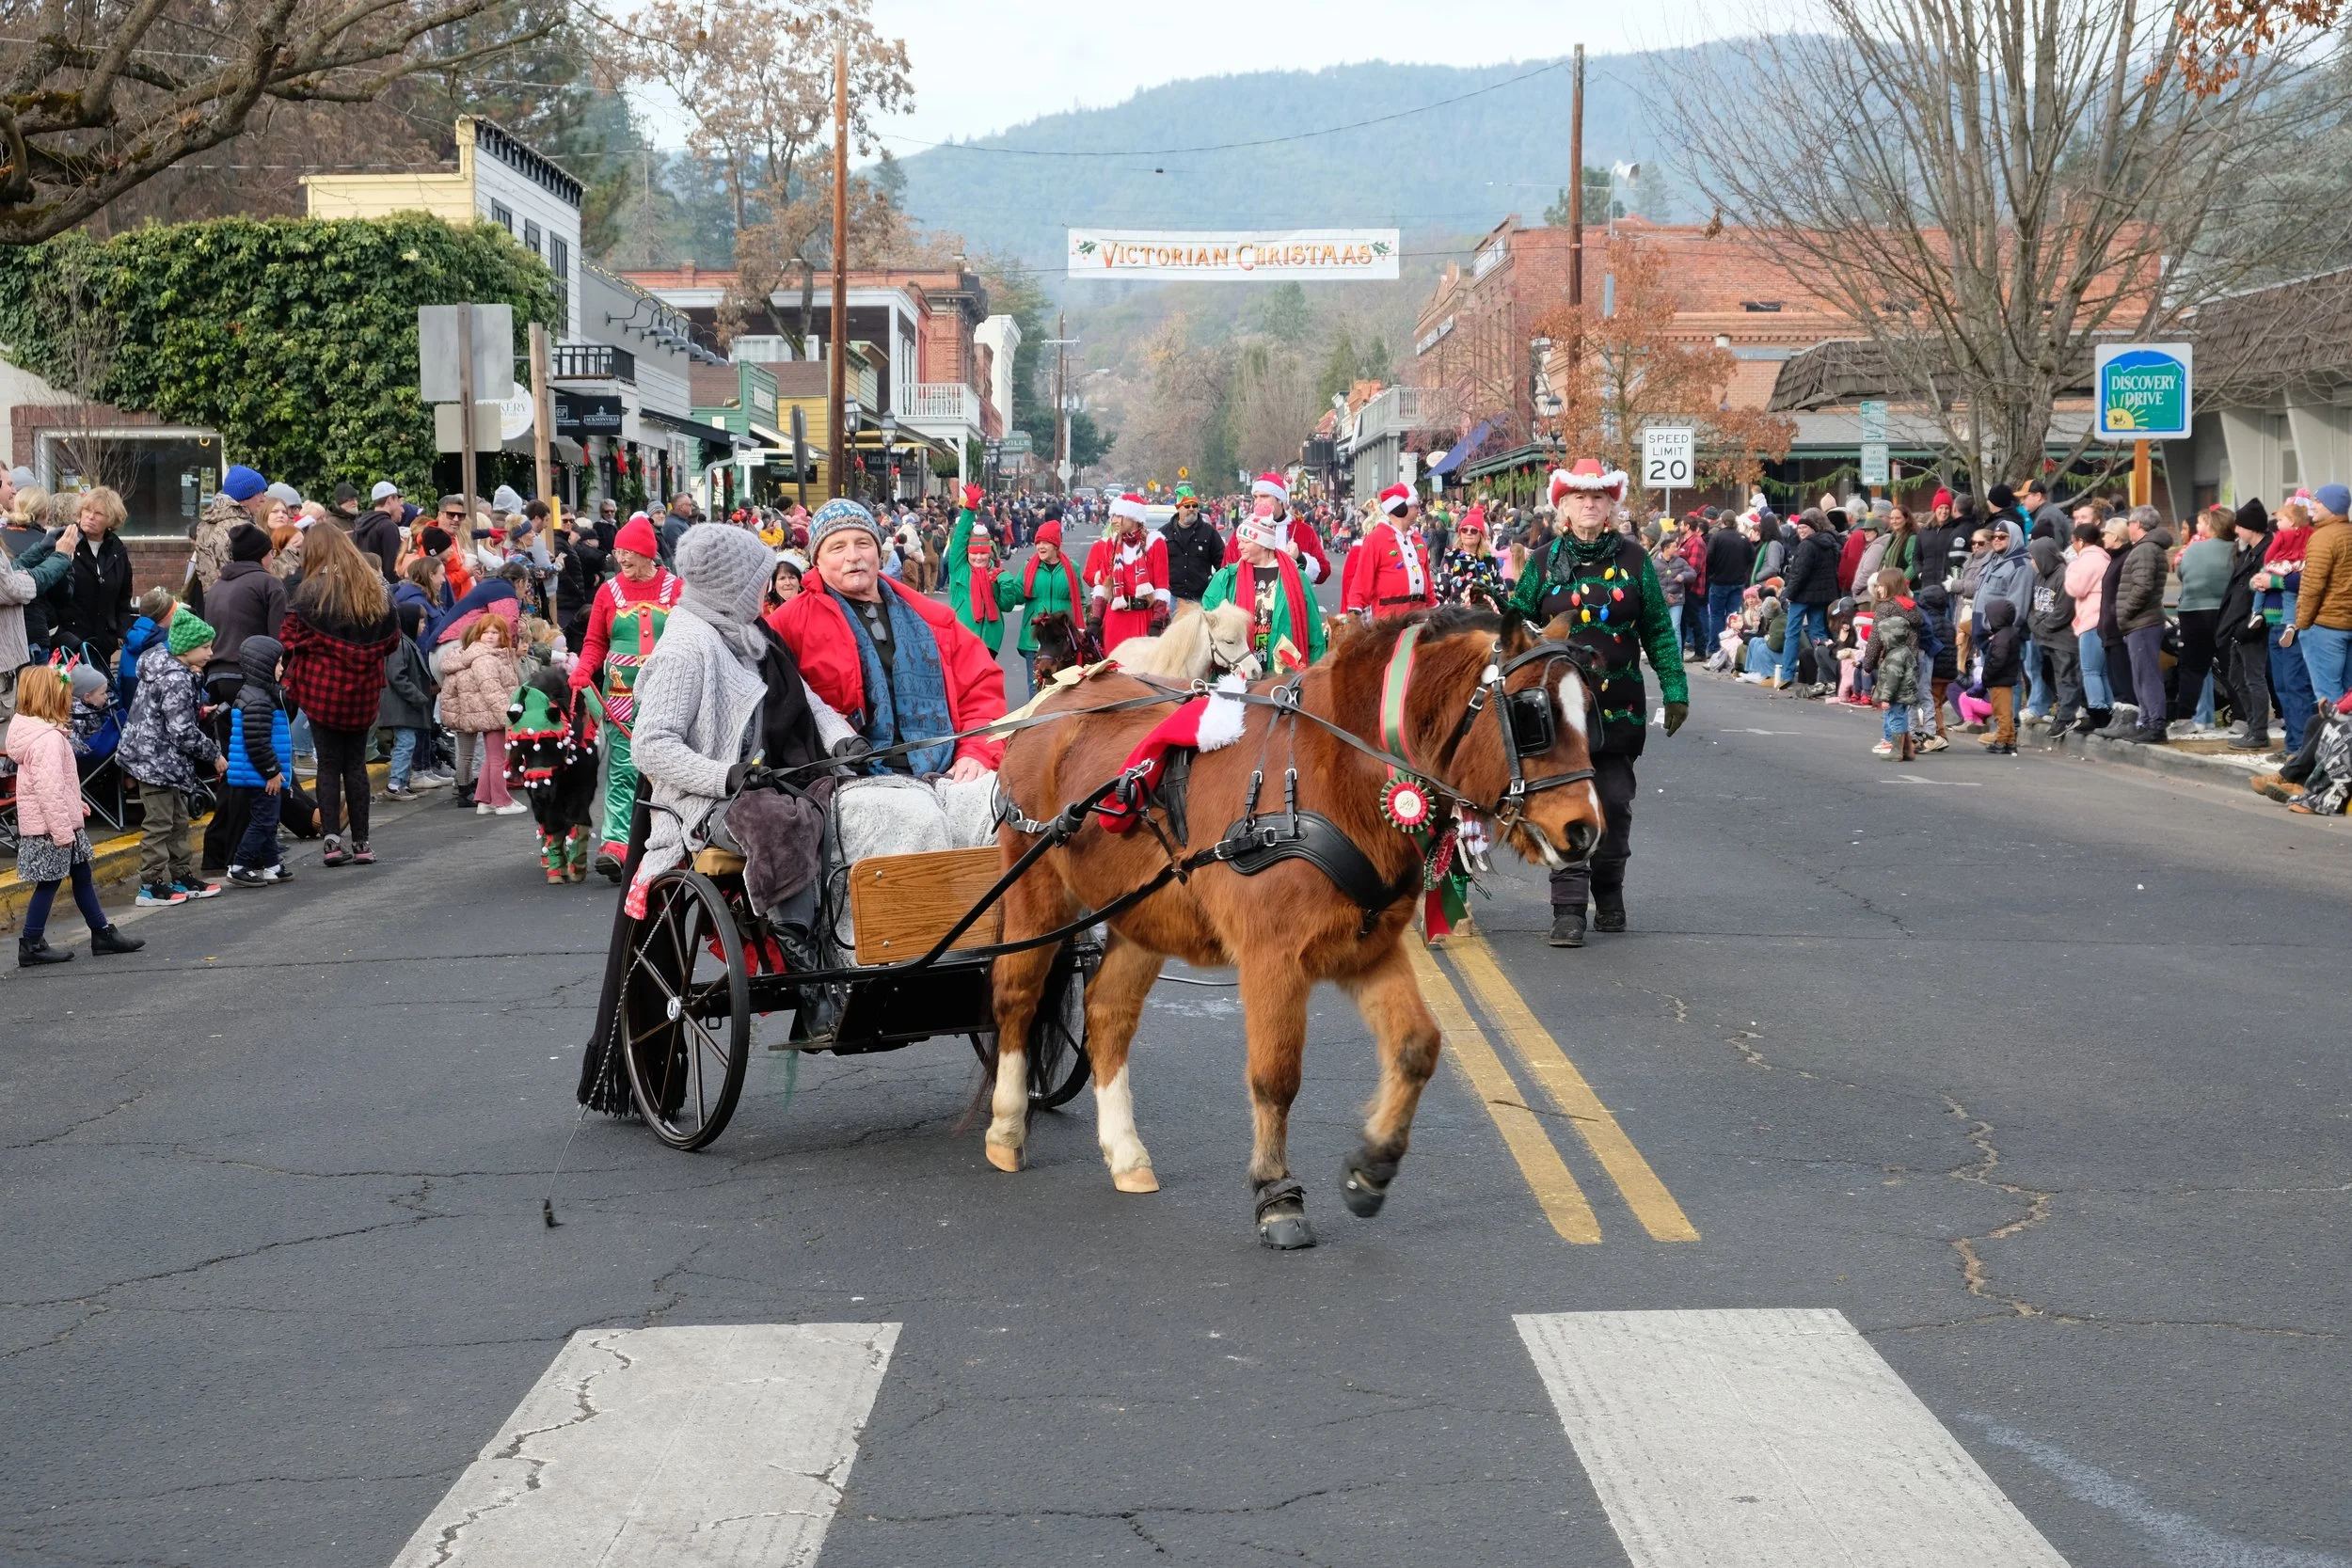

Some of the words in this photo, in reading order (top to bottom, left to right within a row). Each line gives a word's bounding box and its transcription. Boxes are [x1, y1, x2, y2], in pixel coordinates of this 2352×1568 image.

[1100, 242, 1229, 268] VICTORIAN
[1236, 243, 1373, 271] CHRISTMAS
[2111, 375, 2176, 390] DISCOVERY
[2125, 391, 2164, 405] DRIVE
[1648, 434, 1689, 443] SPEED
[1652, 446, 1684, 456] LIMIT
[1649, 459, 1687, 481] 20
